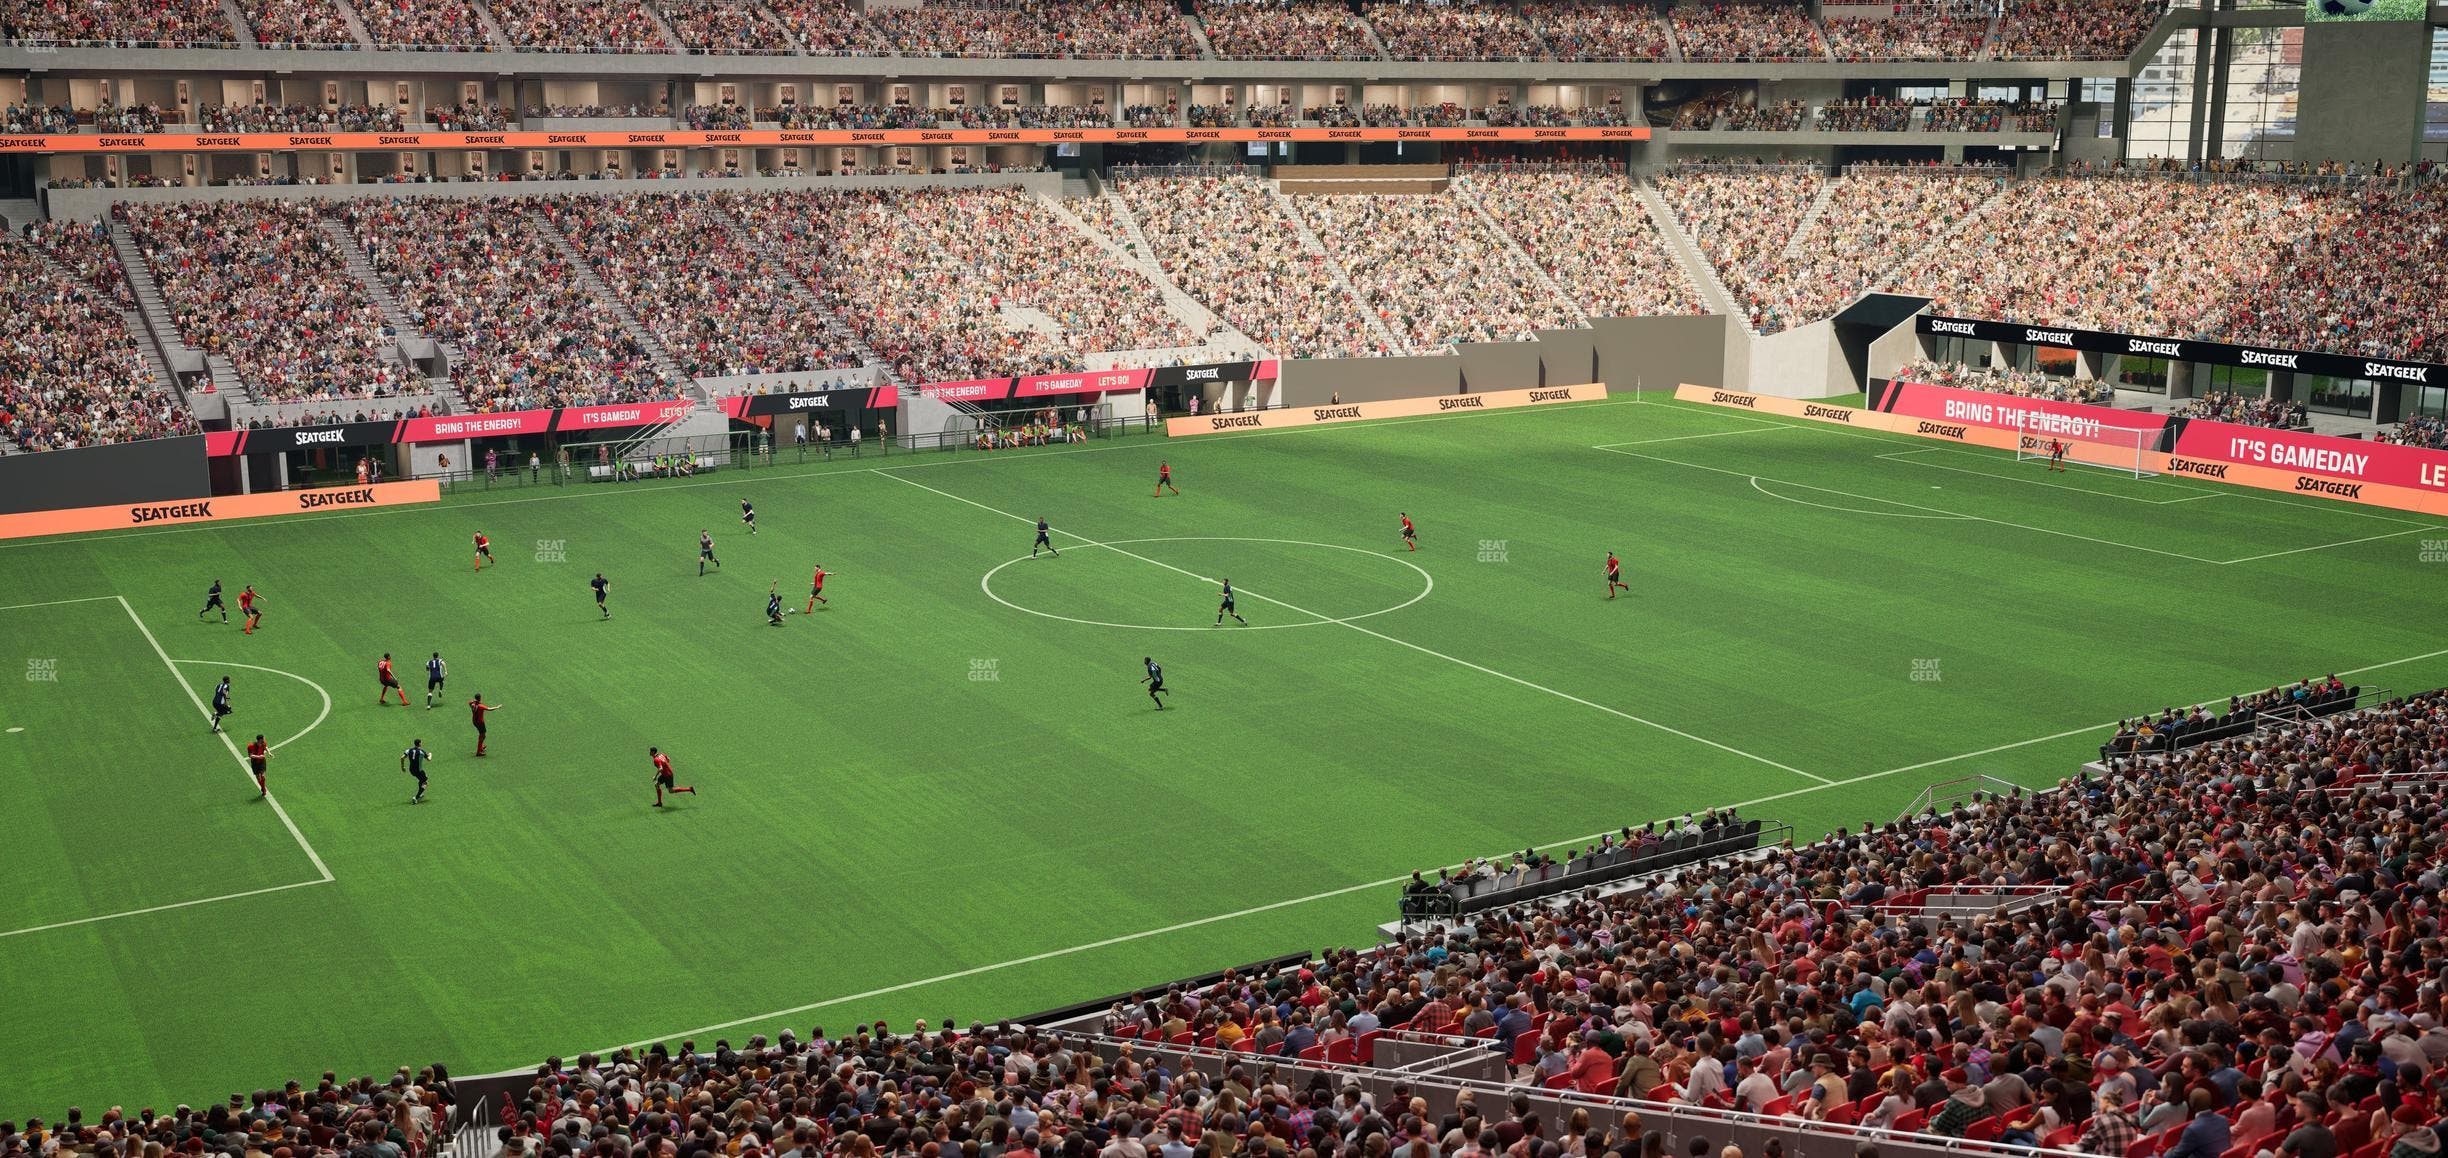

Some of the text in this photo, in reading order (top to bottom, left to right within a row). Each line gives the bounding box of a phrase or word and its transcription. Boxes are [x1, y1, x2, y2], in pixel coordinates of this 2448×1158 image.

[99, 138, 145, 147] SEATGEEK
[197, 138, 240, 147] SEATGEEK
[290, 137, 331, 146] SEATGEEK
[379, 137, 419, 145] SEATGEEK
[466, 136, 504, 144] SEATGEEK
[549, 136, 586, 144] SEATGEEK
[629, 135, 664, 143] SEATGEEK
[706, 134, 741, 142] SEATGEEK
[780, 134, 814, 142] SEATGEEK
[922, 133, 952, 141] SEATGEEK
[1054, 132, 1083, 140] SEATGEEK
[1186, 131, 1219, 139] SEATGEEK
[1931, 319, 1976, 337] SEATGEEK
[2025, 328, 2074, 346] SEATGEEK
[2128, 338, 2181, 358] SEATGEEK
[2241, 349, 2299, 370] SEATGEEK
[1186, 367, 1219, 381] SEATGEEK
[2364, 362, 2428, 383] SEATGEEK
[956, 385, 987, 397] ENERGY!
[1036, 375, 1130, 391] IT'S GAMEDAY LET'S GO!
[789, 394, 829, 411] SEATGEEK
[1439, 396, 1483, 410] SEATGEEK
[1529, 388, 1571, 402] SEATGEEK
[1712, 391, 1756, 408] SEATGEEK
[583, 413, 600, 424] IT'S
[600, 410, 641, 423] GAMEDAY
[1314, 406, 1361, 421] SEATGEEK
[1804, 404, 1853, 423] SEATGEEK
[1946, 400, 2099, 438] BRING THE ENERGY!
[435, 418, 521, 434] BRING THE ENERGY!
[1212, 414, 1262, 430] SEATGEEK
[296, 428, 345, 446] SEATGEEK
[1917, 421, 1967, 440] SEATGEEK
[2020, 436, 2073, 456] SEATGK
[2168, 457, 2229, 480] SEATGEEK
[2231, 438, 2448, 487] IT'S GAMEDAY LE
[2295, 476, 2362, 499] SEATGEEK
[299, 488, 376, 509] SEATGEEK
[131, 501, 213, 524] SEATGEEK
